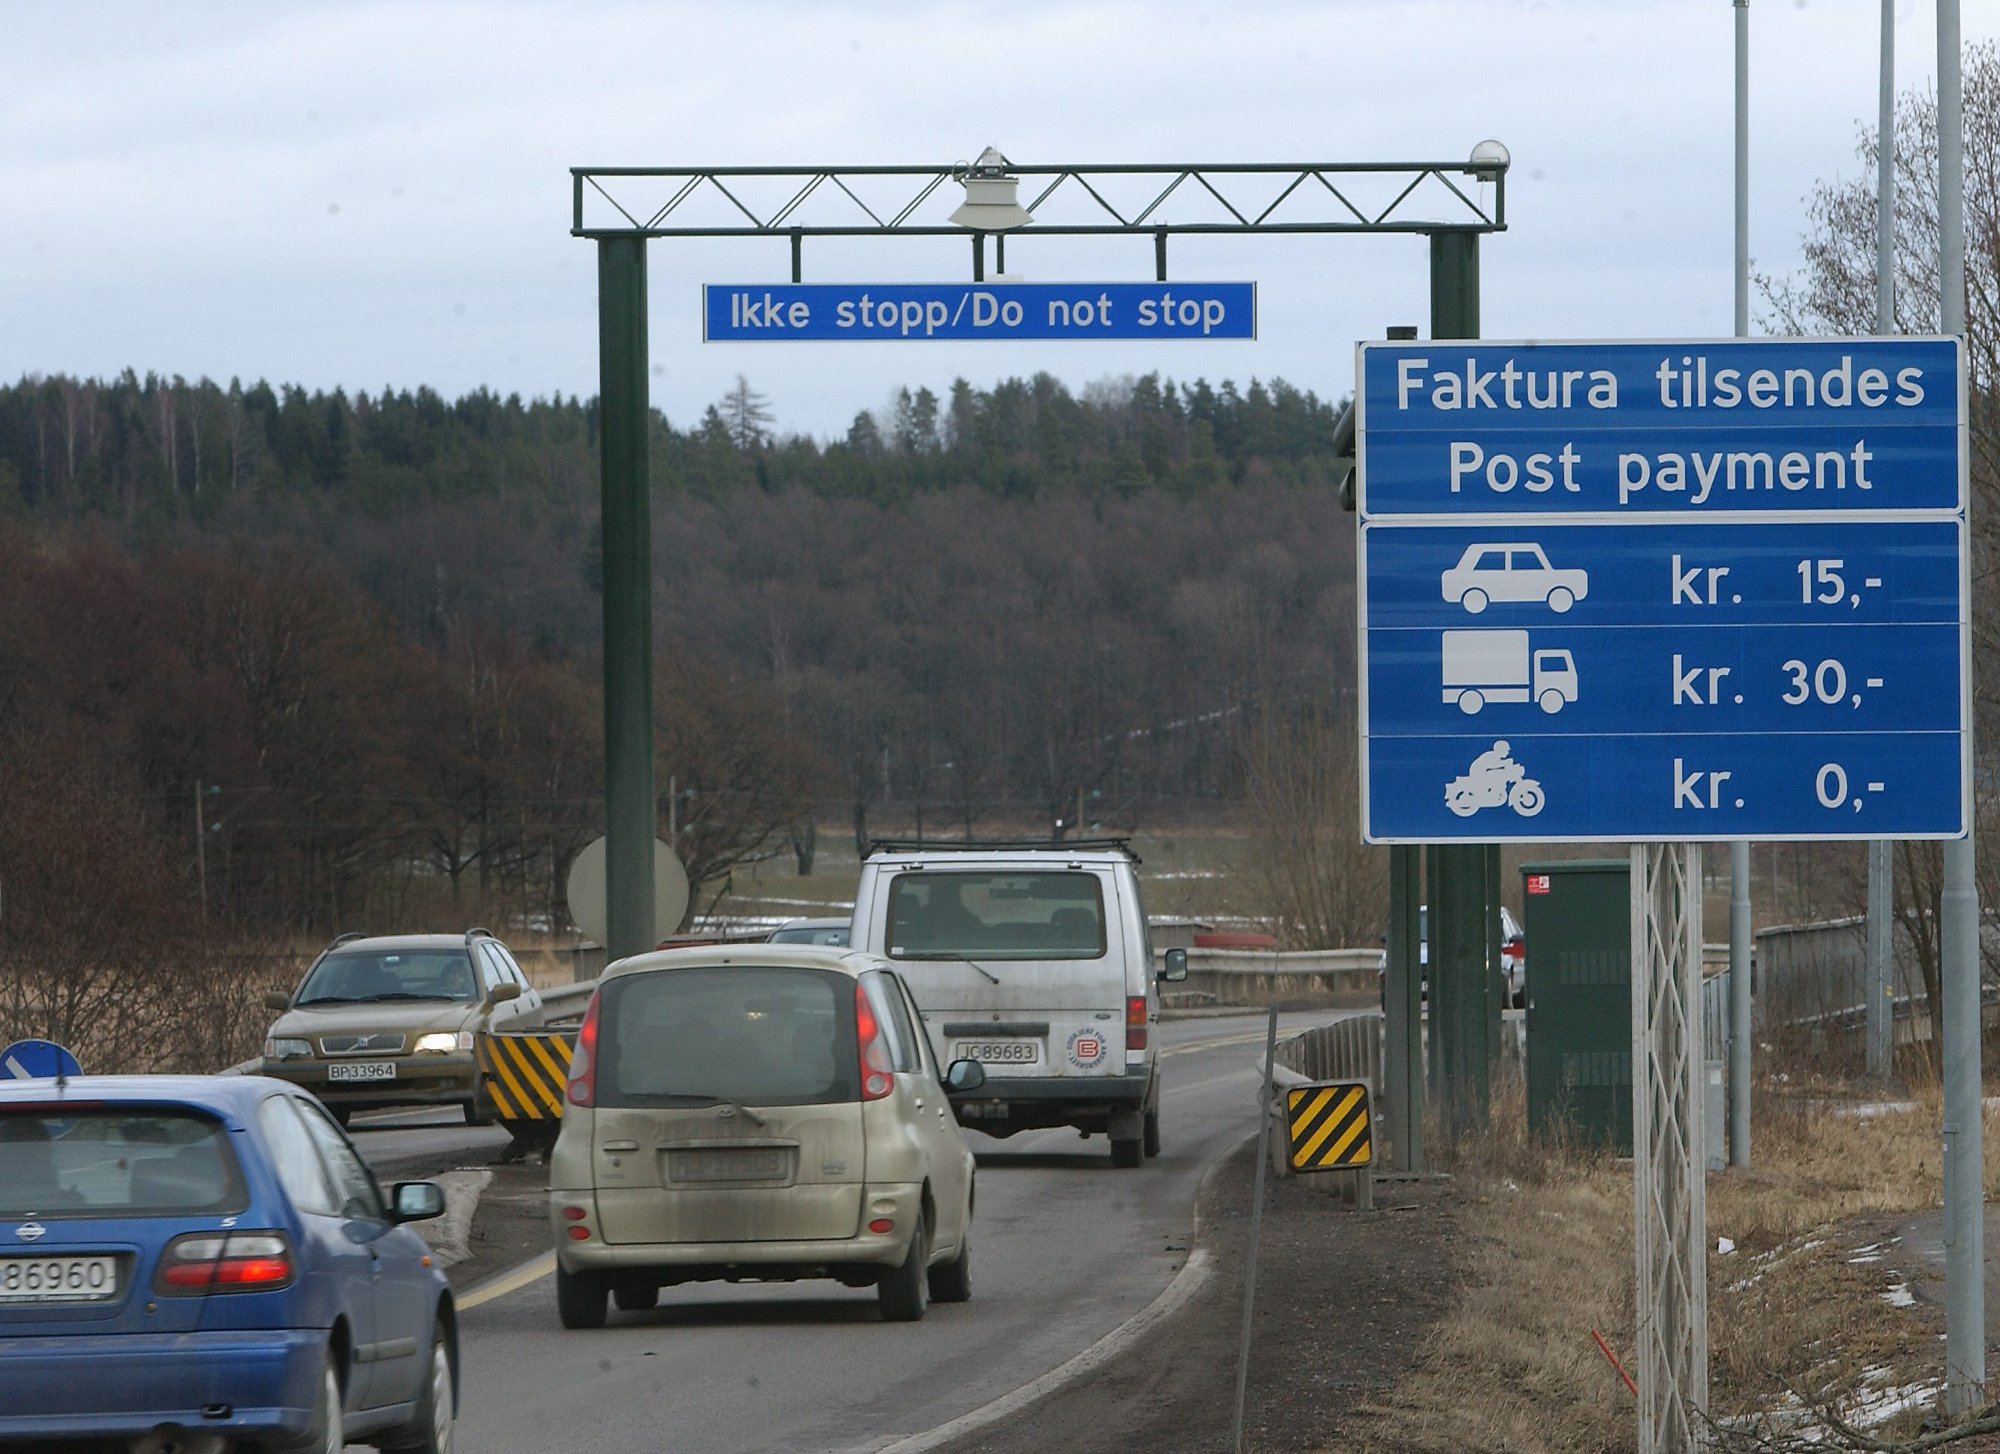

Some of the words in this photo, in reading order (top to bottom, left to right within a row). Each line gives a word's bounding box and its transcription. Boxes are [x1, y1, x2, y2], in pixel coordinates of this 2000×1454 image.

[731, 294, 810, 328] Ikke
[1048, 292, 1113, 326] not
[1137, 293, 1225, 333] stop
[1397, 358, 1618, 410] Faktura
[1655, 355, 1925, 408] tilsendes
[1450, 442, 1581, 493] Post
[1618, 439, 1874, 504] payment
[1672, 554, 1742, 605] kr.
[1797, 559, 1882, 609] 15,-
[1673, 654, 1744, 705] kr.
[1782, 659, 1884, 709] 30,-
[1674, 758, 1745, 809] kr.
[1816, 763, 1885, 813] 0,-
[5, 1262, 106, 1290] 86960
